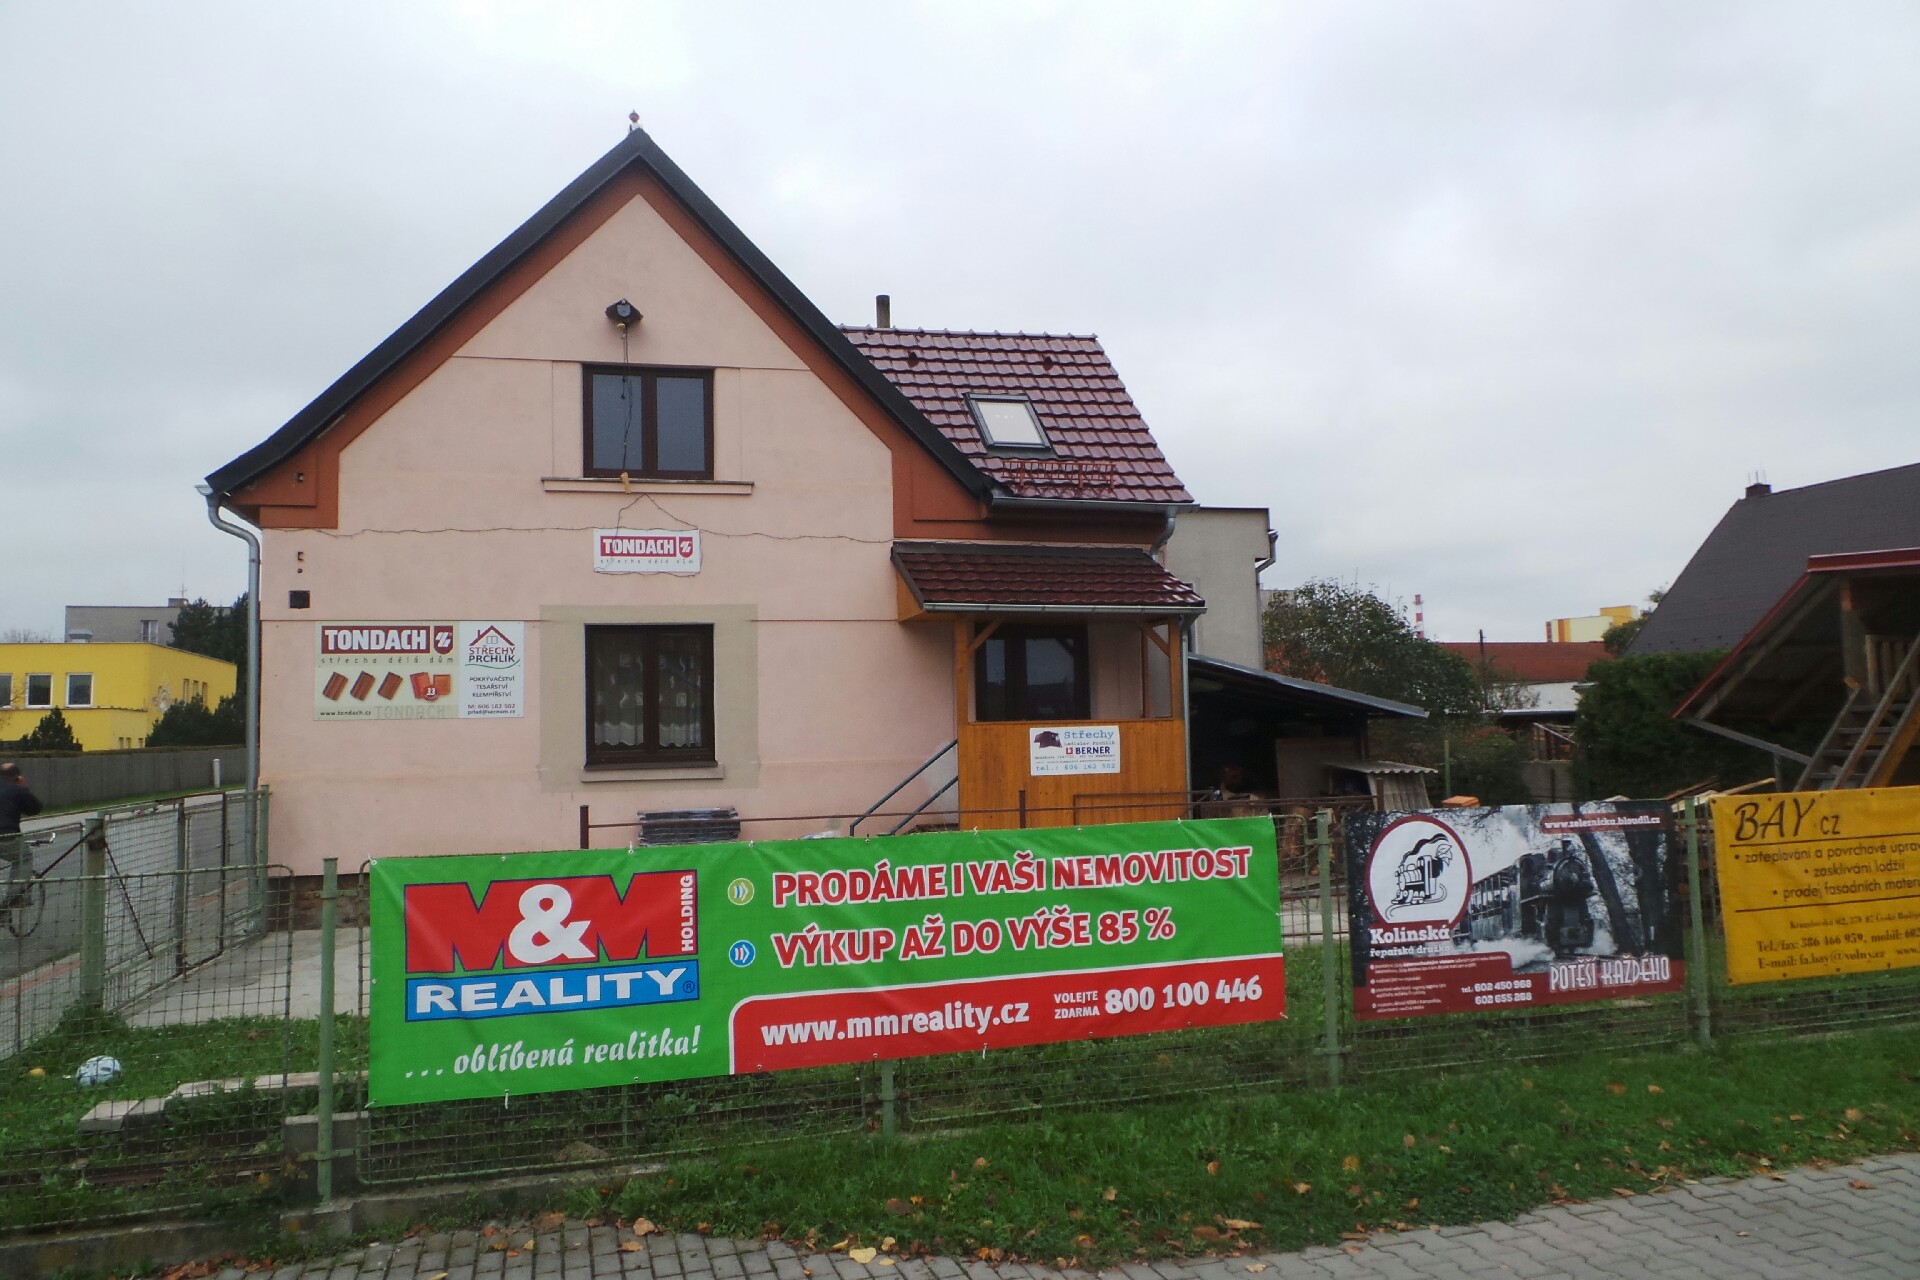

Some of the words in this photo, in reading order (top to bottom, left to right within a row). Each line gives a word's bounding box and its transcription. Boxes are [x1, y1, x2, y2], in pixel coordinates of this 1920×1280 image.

[603, 538, 673, 554] TONDACH
[325, 629, 427, 650] TONDACH
[468, 644, 516, 655] STŘECHY
[321, 656, 377, 664] střecha
[388, 656, 419, 664] dělá
[430, 656, 454, 664] dům
[468, 654, 516, 662] PRCHLÍK
[426, 688, 436, 696] 33
[374, 704, 446, 718] TONDACH
[1064, 730, 1114, 740] Střechy
[1076, 746, 1110, 754] BERNER
[1734, 798, 1815, 841] BAY
[1816, 848, 1823, 859] a
[773, 858, 946, 908] PRODÁME
[951, 862, 965, 897] I
[968, 850, 1046, 895] VAŠI
[1052, 846, 1252, 890] NEMOVITOST
[1783, 882, 1823, 901] prodej
[681, 874, 694, 952] HOLDING
[404, 869, 698, 974] M&M
[771, 922, 895, 968] VÝKUP
[899, 914, 945, 960] AŽ
[952, 920, 1002, 956] DO
[1005, 904, 1092, 951] VÝŠE
[1098, 910, 1139, 945] 85
[1144, 906, 1175, 940] %
[1368, 924, 1450, 944] Kolínská
[1370, 946, 1414, 958] řepařská
[1758, 956, 1797, 970] E-mail:
[1550, 956, 1598, 992] POTĚŠÍ
[1600, 952, 1670, 986] KAŽDÉHO
[416, 968, 687, 1013] REALITY
[1054, 990, 1098, 1004] VOLEJTE
[1104, 986, 1155, 1014] 800
[1162, 980, 1210, 1008] 100
[1216, 975, 1263, 1004] 446
[1474, 982, 1494, 992] 602
[1494, 981, 1512, 990] 450
[1475, 995, 1494, 1005] 602
[1494, 994, 1512, 1003] 655
[1054, 1006, 1100, 1020] ZDARMA
[761, 1001, 1030, 1046] www.mmreality.cz
[454, 1038, 574, 1074] oblíbená
[582, 1024, 701, 1064] realitka!
